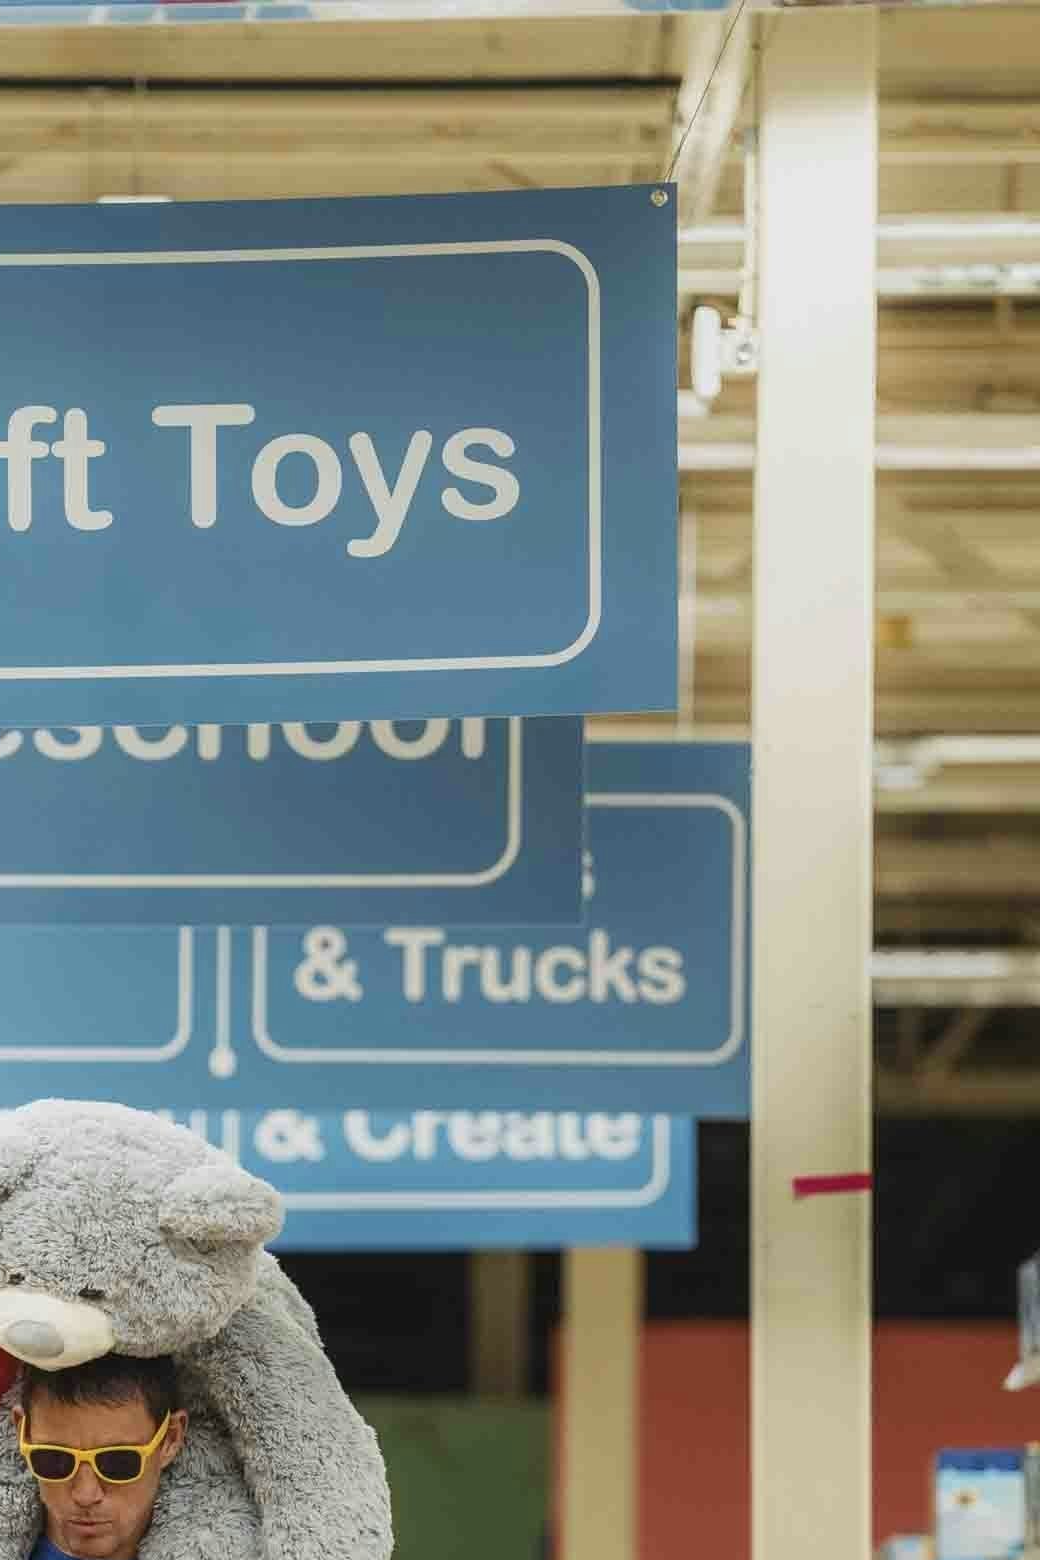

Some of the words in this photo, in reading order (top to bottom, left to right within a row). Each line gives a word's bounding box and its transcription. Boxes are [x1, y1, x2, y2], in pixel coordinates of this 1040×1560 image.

[150, 402, 521, 559] Toys
[294, 926, 363, 1002] &
[383, 927, 687, 1004] Trucks
[253, 1110, 324, 1162] &
